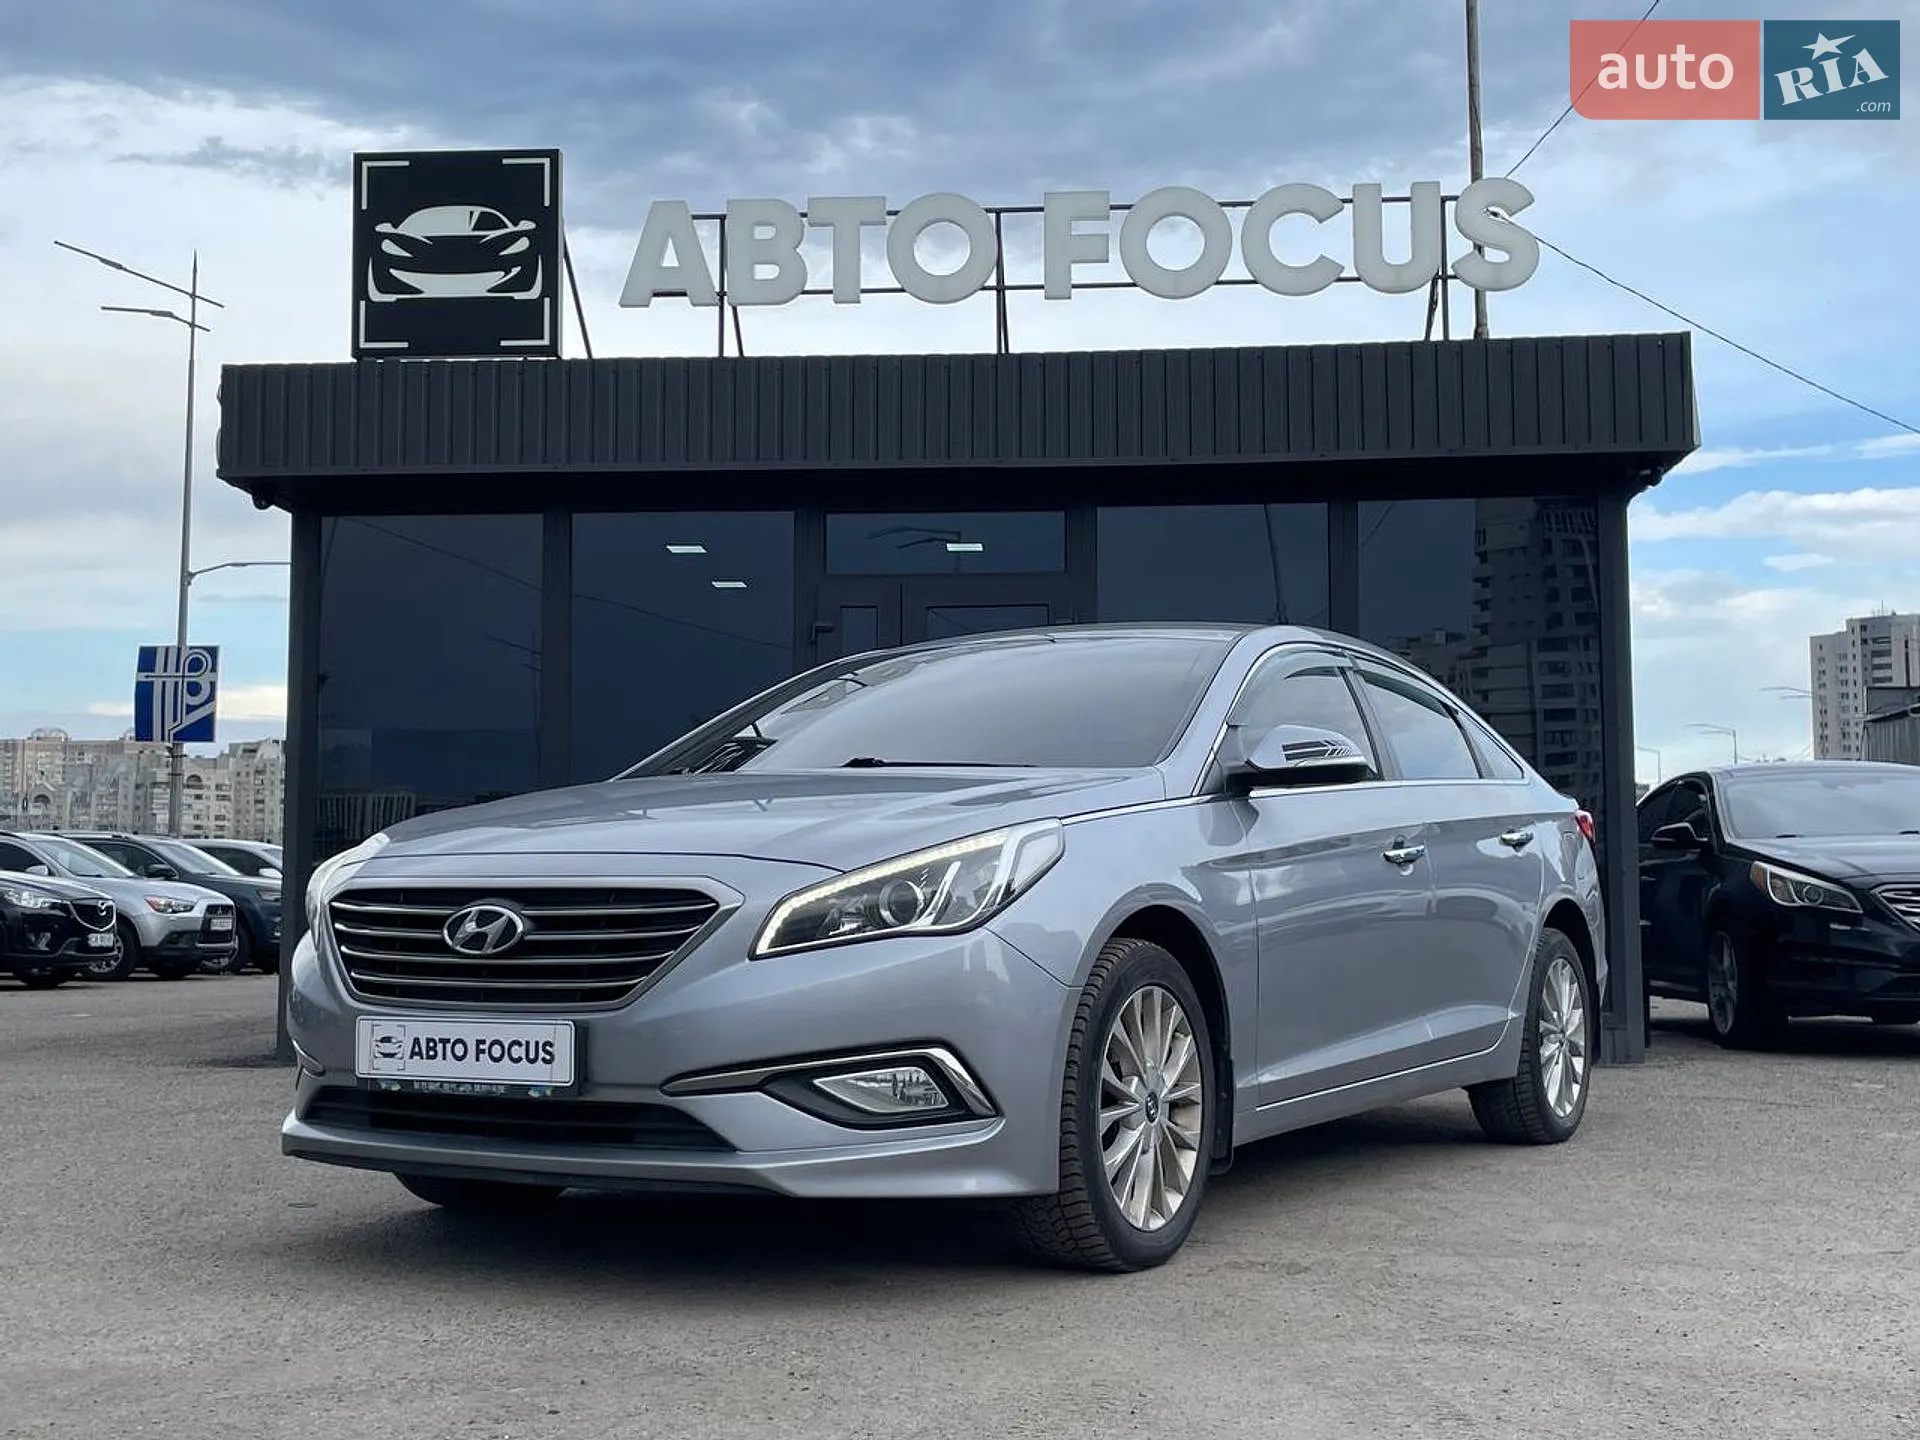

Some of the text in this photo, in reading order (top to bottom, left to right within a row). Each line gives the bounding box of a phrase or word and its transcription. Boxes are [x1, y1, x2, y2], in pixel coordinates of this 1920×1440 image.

[619, 177, 1540, 307] АВТО FOCUS
[409, 1036, 556, 1065] АВТО FOCUS
